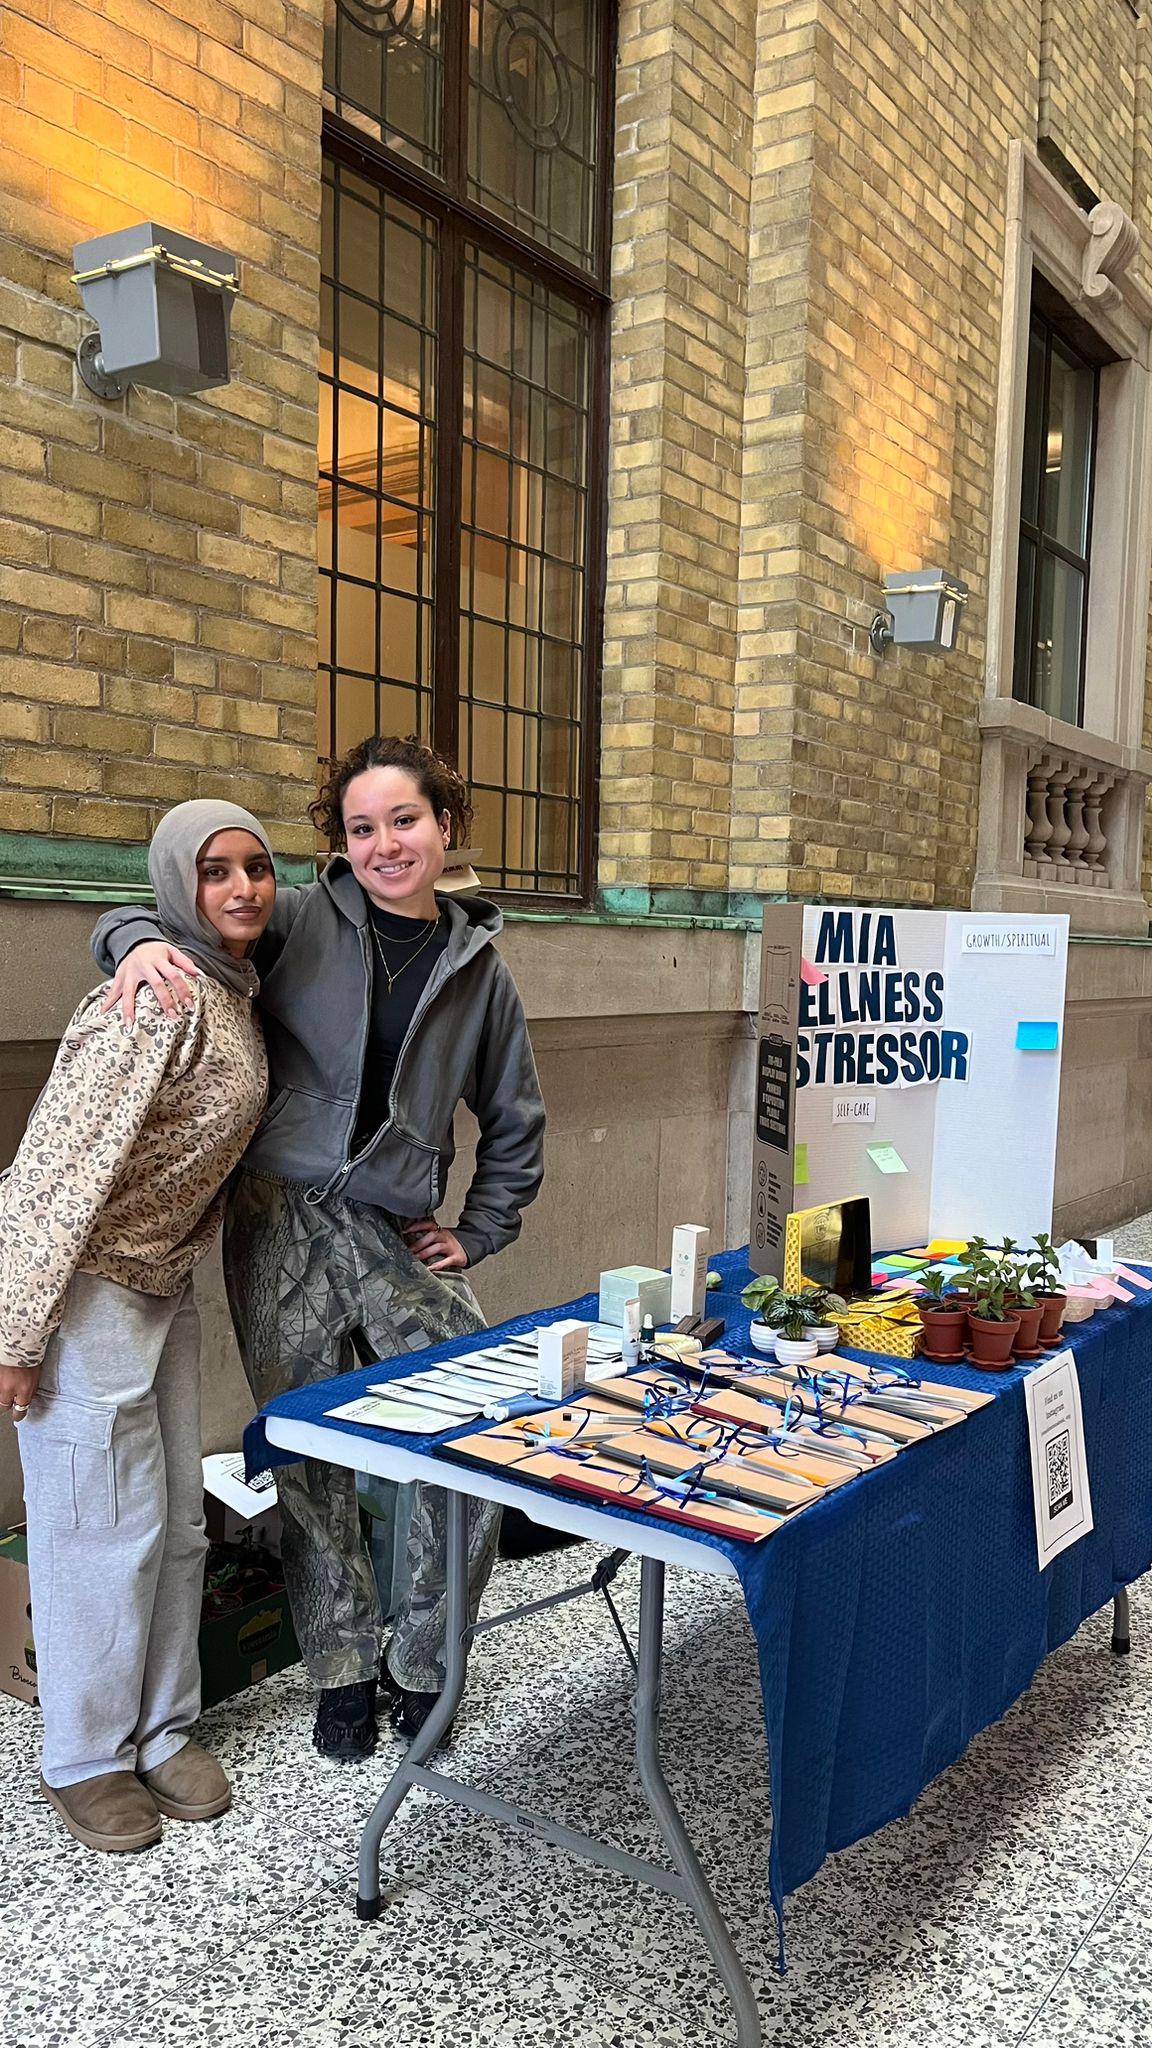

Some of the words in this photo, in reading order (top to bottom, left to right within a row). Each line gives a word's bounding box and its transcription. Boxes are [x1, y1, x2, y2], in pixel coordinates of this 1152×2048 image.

[815, 911, 897, 966] MIA
[966, 933, 1050, 948] GROWTH/SPIRITUAL
[836, 1102, 870, 1117] SELF-CARE
